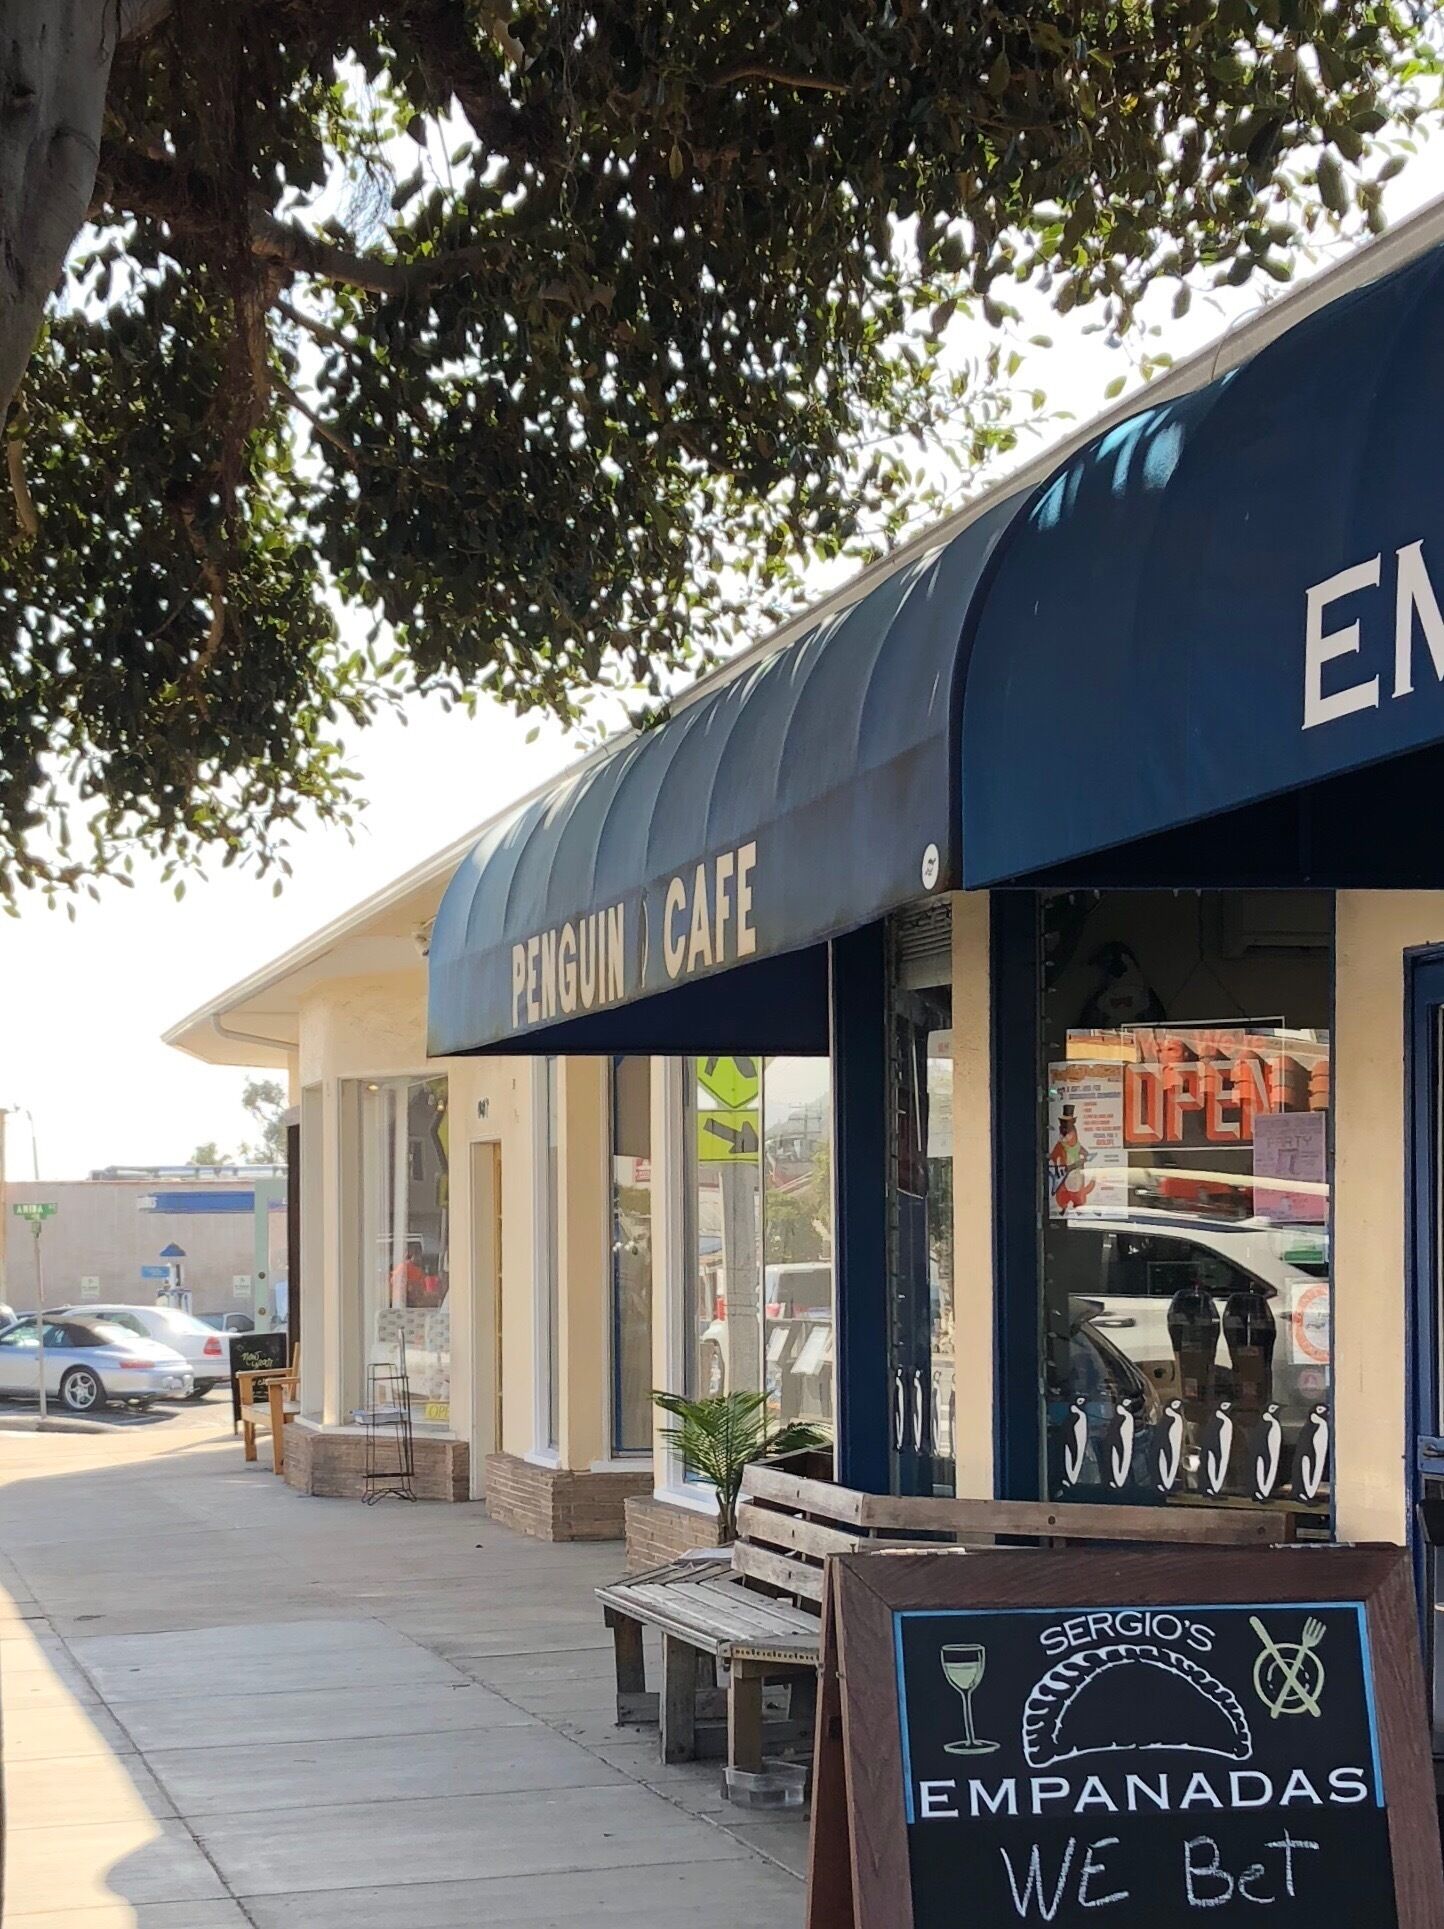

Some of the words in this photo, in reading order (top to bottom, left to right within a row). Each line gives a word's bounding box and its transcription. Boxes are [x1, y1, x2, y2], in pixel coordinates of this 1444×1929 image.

[512, 903, 625, 1028] PENGUIN
[663, 840, 758, 980] CAFE
[1125, 1059, 1278, 1143] OPEN
[1040, 1611, 1216, 1655] SERGIO'S
[918, 1767, 1369, 1818] EMPANADAS
[1000, 1837, 1130, 1921] WE
